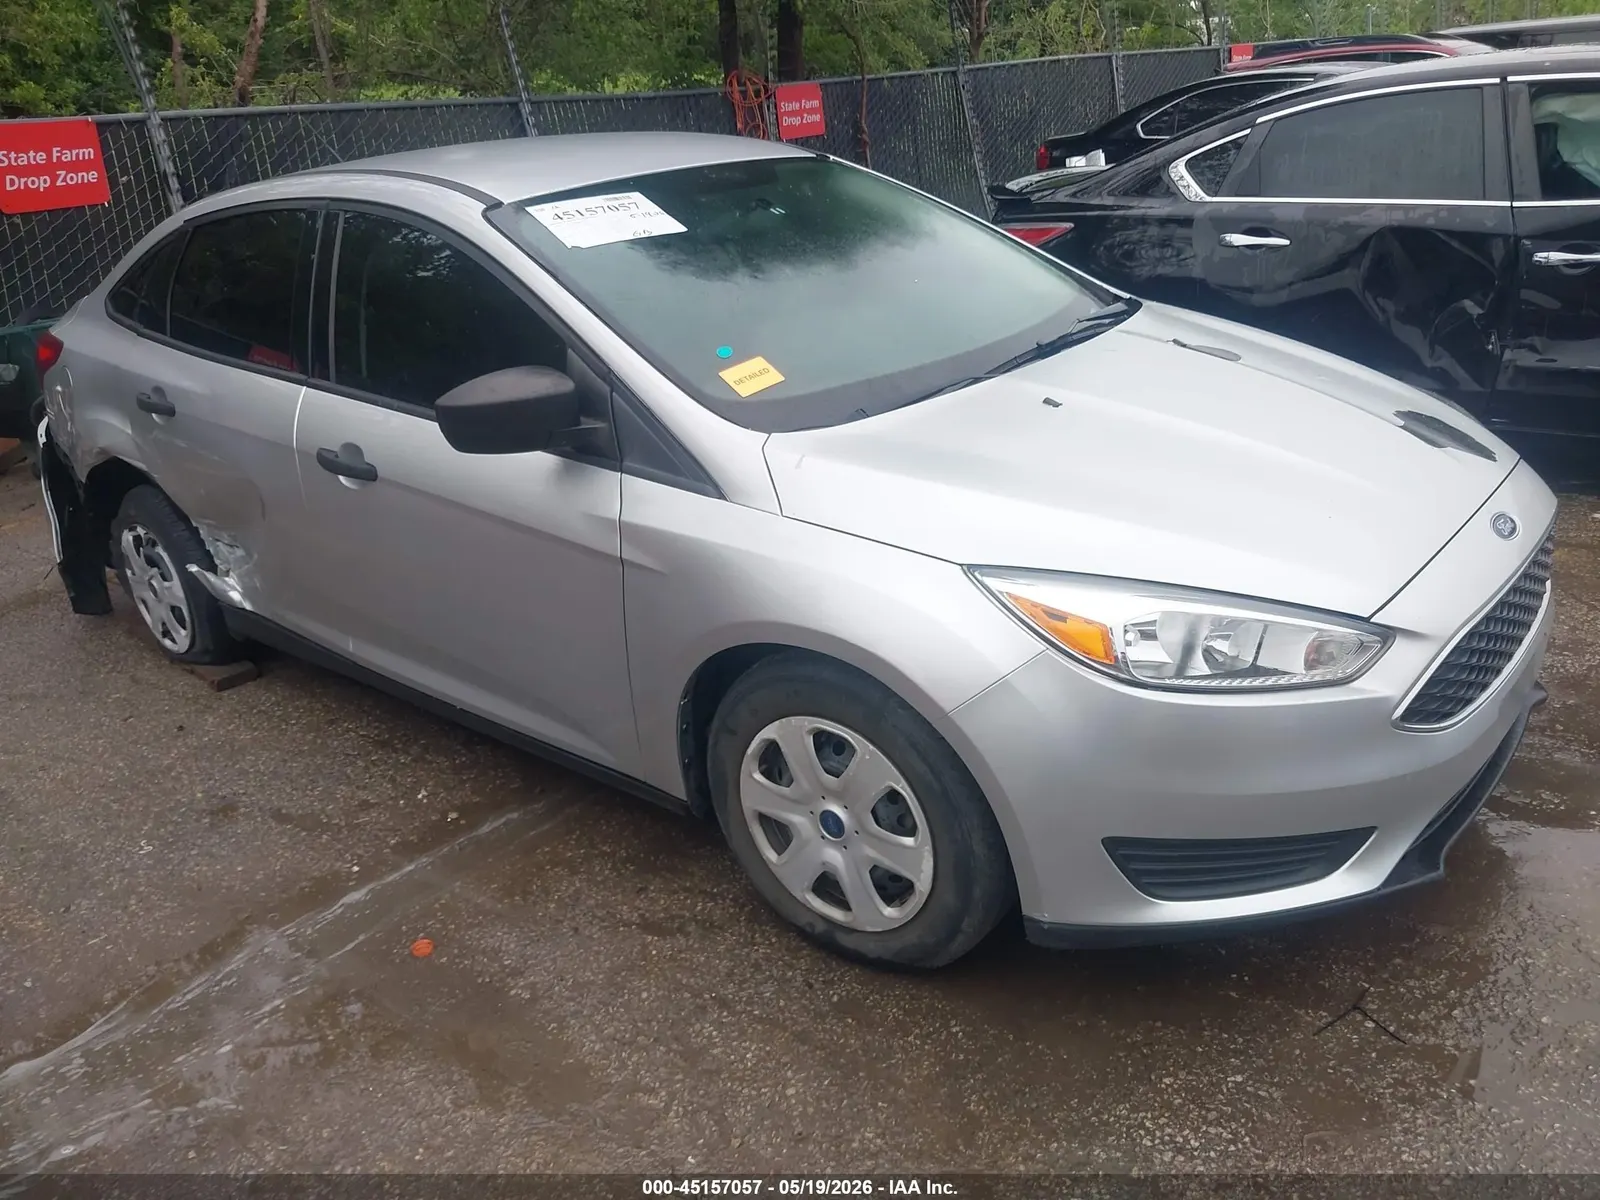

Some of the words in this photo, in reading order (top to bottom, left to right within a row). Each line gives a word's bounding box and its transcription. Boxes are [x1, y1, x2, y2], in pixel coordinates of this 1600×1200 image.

[781, 100, 800, 112] State
[801, 99, 820, 109] Farm
[782, 116, 801, 126] Drop
[802, 113, 821, 123] Zone
[0, 150, 47, 167] State
[52, 147, 94, 162] Farm
[5, 174, 51, 192] Drop
[55, 170, 98, 186] Zone
[553, 202, 640, 220] 45157057
[733, 367, 770, 386] DETAILED
